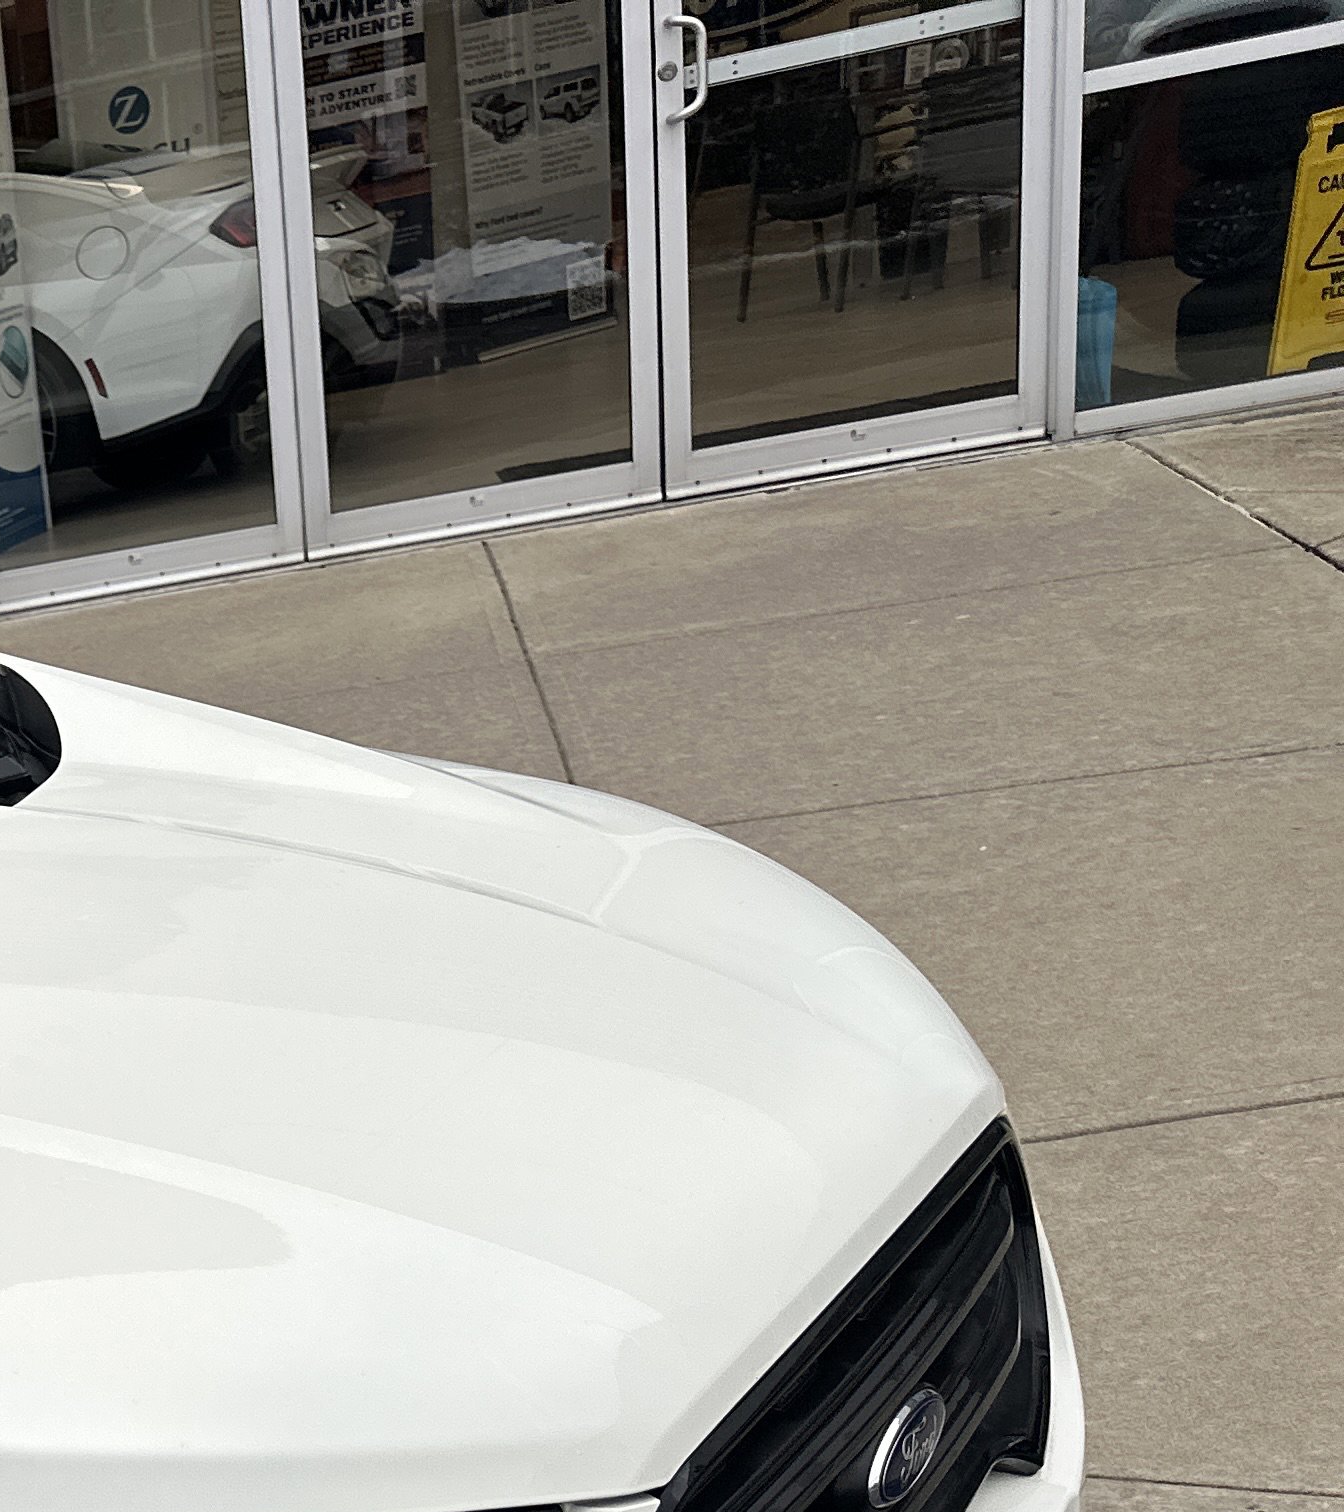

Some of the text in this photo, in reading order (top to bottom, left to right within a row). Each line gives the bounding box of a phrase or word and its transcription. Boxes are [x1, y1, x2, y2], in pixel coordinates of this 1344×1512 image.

[320, 92, 334, 103] TO
[338, 83, 376, 100] START
[320, 92, 392, 117] ADVENTURE
[900, 1415, 938, 1487] Ford
